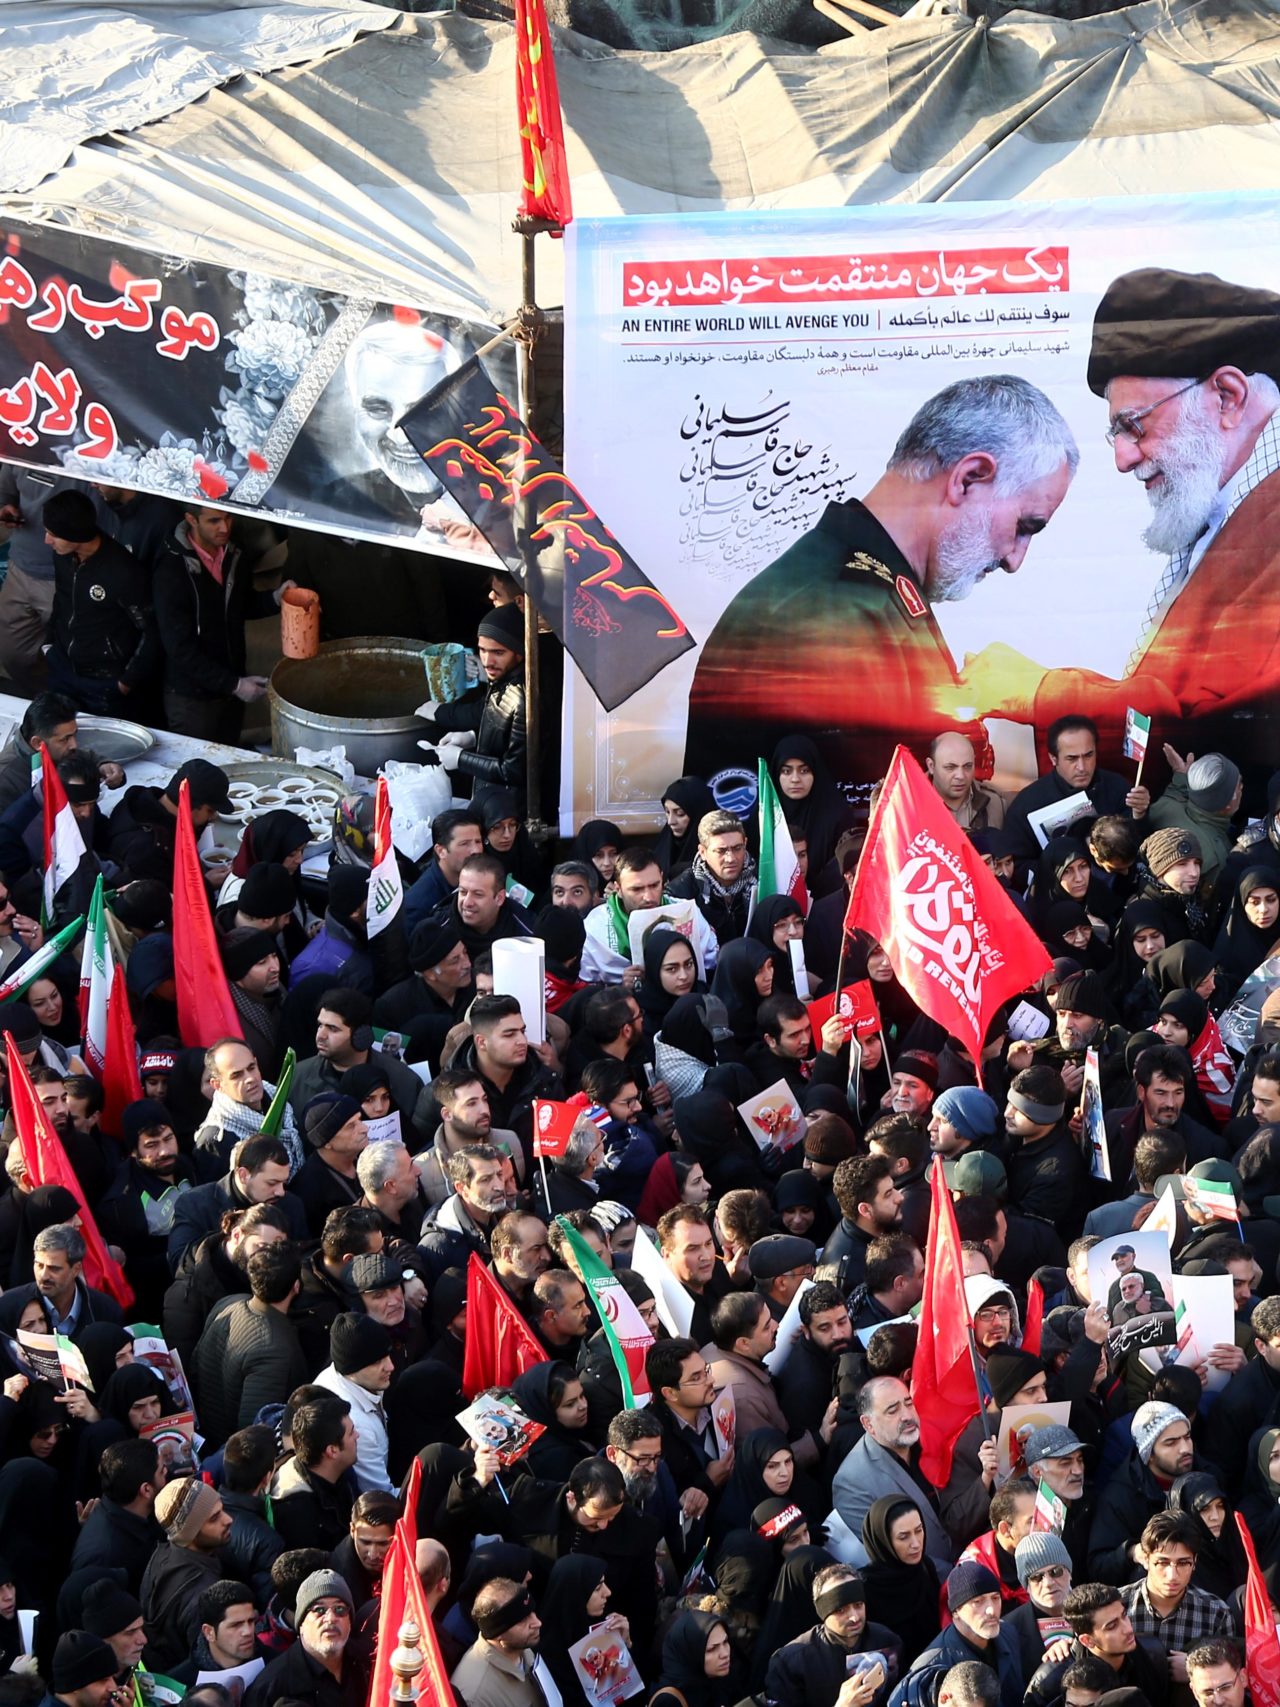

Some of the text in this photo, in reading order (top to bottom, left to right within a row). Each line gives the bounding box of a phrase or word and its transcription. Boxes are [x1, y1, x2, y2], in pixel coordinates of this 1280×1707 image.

[628, 246, 1065, 307] یک جهان منتقمت خواهد بود
[0, 256, 222, 361] موکب ره
[1034, 305, 1070, 323] سوف
[621, 313, 870, 333] AN ENTIRE WORLD WILL AVENGE YOU
[766, 346, 815, 363] دلبستگان
[849, 347, 876, 359] است
[879, 347, 919, 361] مقاومت
[999, 341, 1042, 357] سلیمانی
[1043, 342, 1070, 352] شهید
[664, 353, 673, 366] او
[675, 353, 715, 366] خونخواه
[816, 365, 879, 377] مقام معظم رهبری
